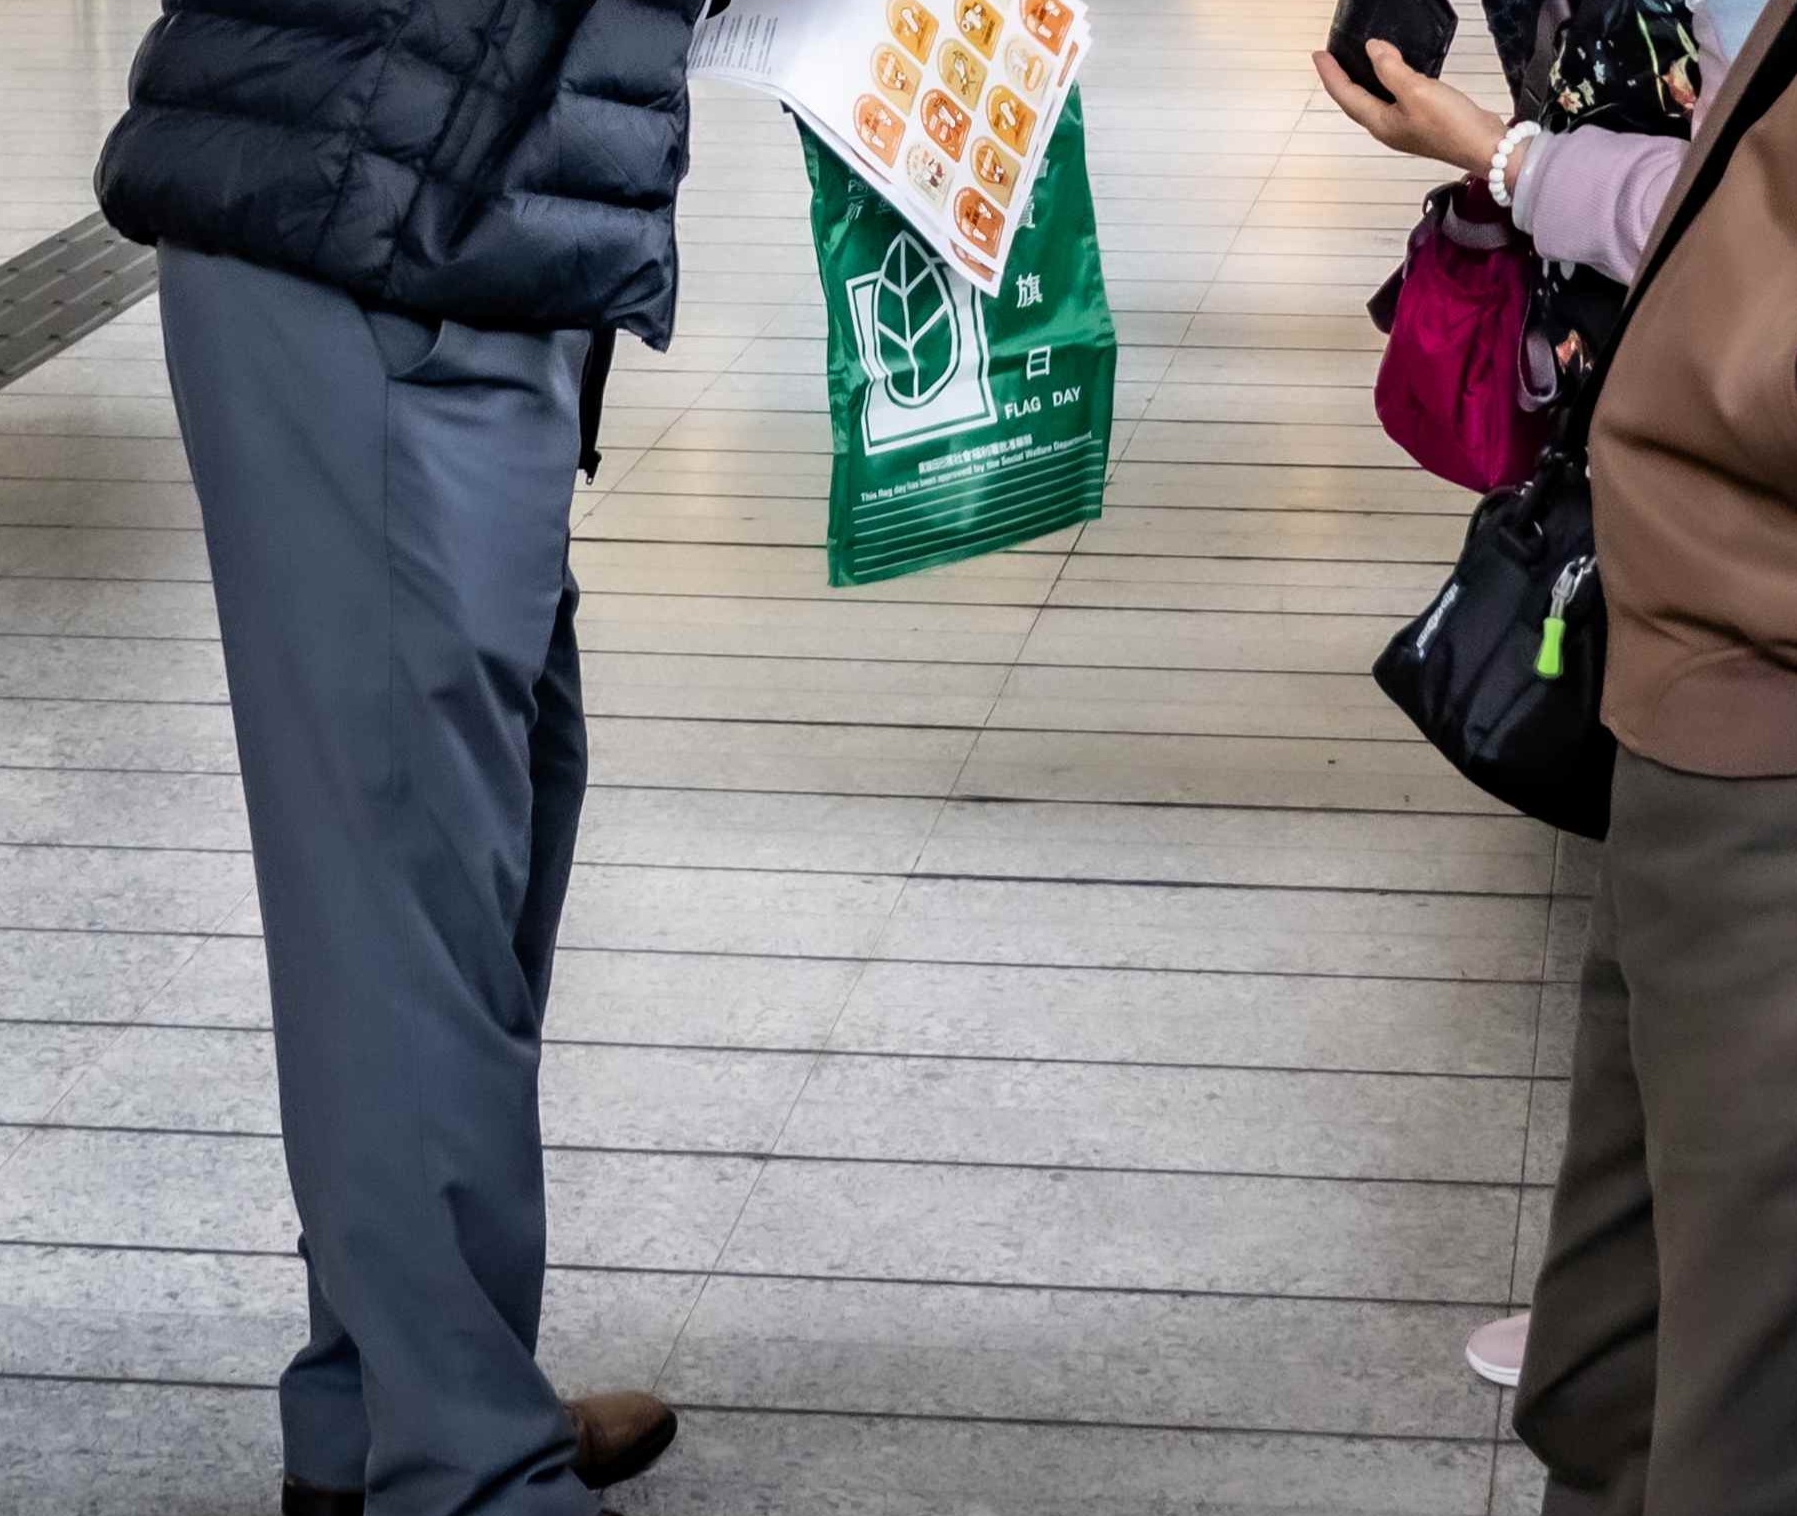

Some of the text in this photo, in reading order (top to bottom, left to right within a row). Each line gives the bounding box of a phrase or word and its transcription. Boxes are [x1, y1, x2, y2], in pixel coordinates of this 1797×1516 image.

[1004, 385, 1082, 420] FLAG DAY
[861, 491, 877, 502] This
[973, 463, 984, 474] by
[1001, 452, 1024, 467] Social
[1025, 444, 1052, 460] Welfare
